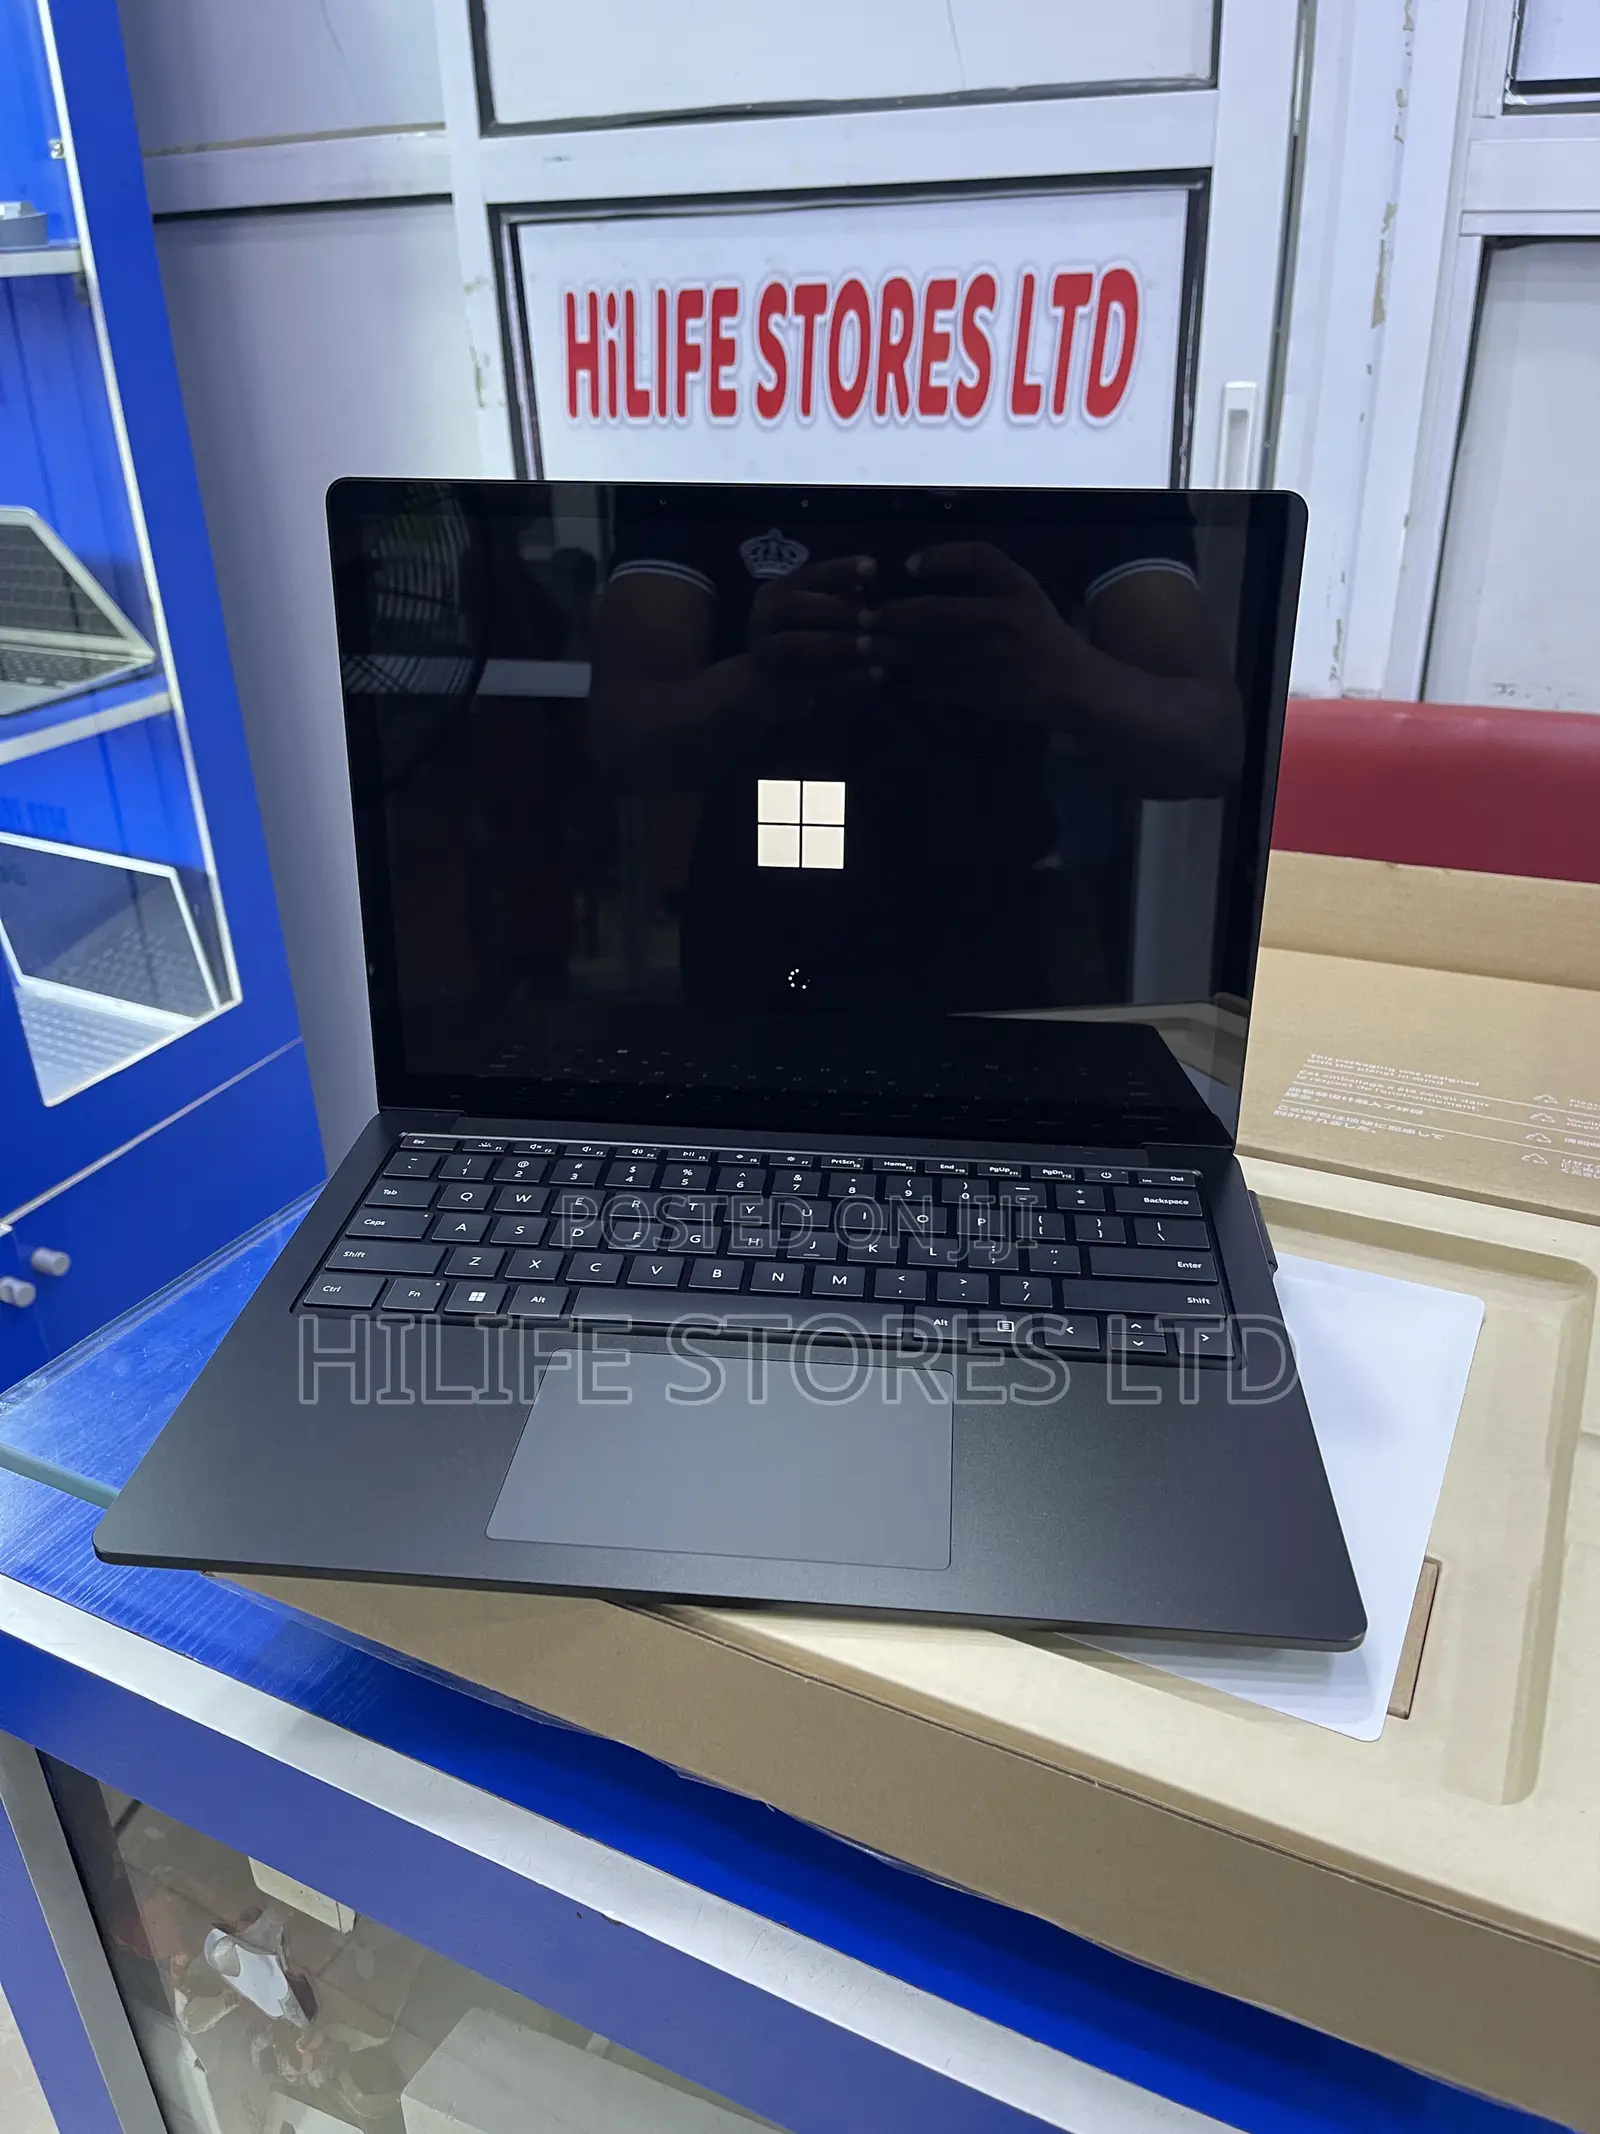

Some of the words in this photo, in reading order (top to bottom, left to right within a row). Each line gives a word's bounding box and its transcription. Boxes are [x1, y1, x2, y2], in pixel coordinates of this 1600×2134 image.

[565, 286, 740, 419] HiLIFE
[755, 271, 997, 420] STORES
[1009, 267, 1140, 420] LTD
[830, 1158, 856, 1166] PrtScn
[1042, 1168, 1065, 1177] PgDn
[460, 1192, 474, 1202] Q
[516, 1194, 532, 1203] W
[574, 1197, 585, 1206] E
[1143, 1197, 1189, 1205] Backspace
[631, 1199, 642, 1209] R
[688, 1202, 699, 1211] T
[745, 1205, 756, 1214] Y
[801, 1208, 813, 1217] U
[363, 1218, 386, 1227] Caps
[916, 1214, 930, 1224] O
[977, 1217, 987, 1227] P
[454, 1222, 467, 1232] A
[514, 1225, 525, 1235] S
[571, 1227, 585, 1237] D
[632, 1231, 642, 1241] F
[689, 1234, 702, 1244] G
[747, 1237, 760, 1247] H
[809, 1240, 817, 1250] J
[868, 1243, 879, 1253] K
[929, 1246, 938, 1256] L
[342, 1250, 366, 1258] Shift
[468, 1256, 482, 1266] Z
[529, 1259, 542, 1269] X
[1177, 1261, 1202, 1269] Enter
[589, 1262, 602, 1272] C
[651, 1265, 663, 1275] V
[712, 1268, 722, 1278] B
[771, 1272, 785, 1282] N
[832, 1275, 848, 1285] M
[322, 1285, 342, 1293] Ctrl
[1186, 1296, 1211, 1305] Shift
[932, 1318, 948, 1327] Alt
